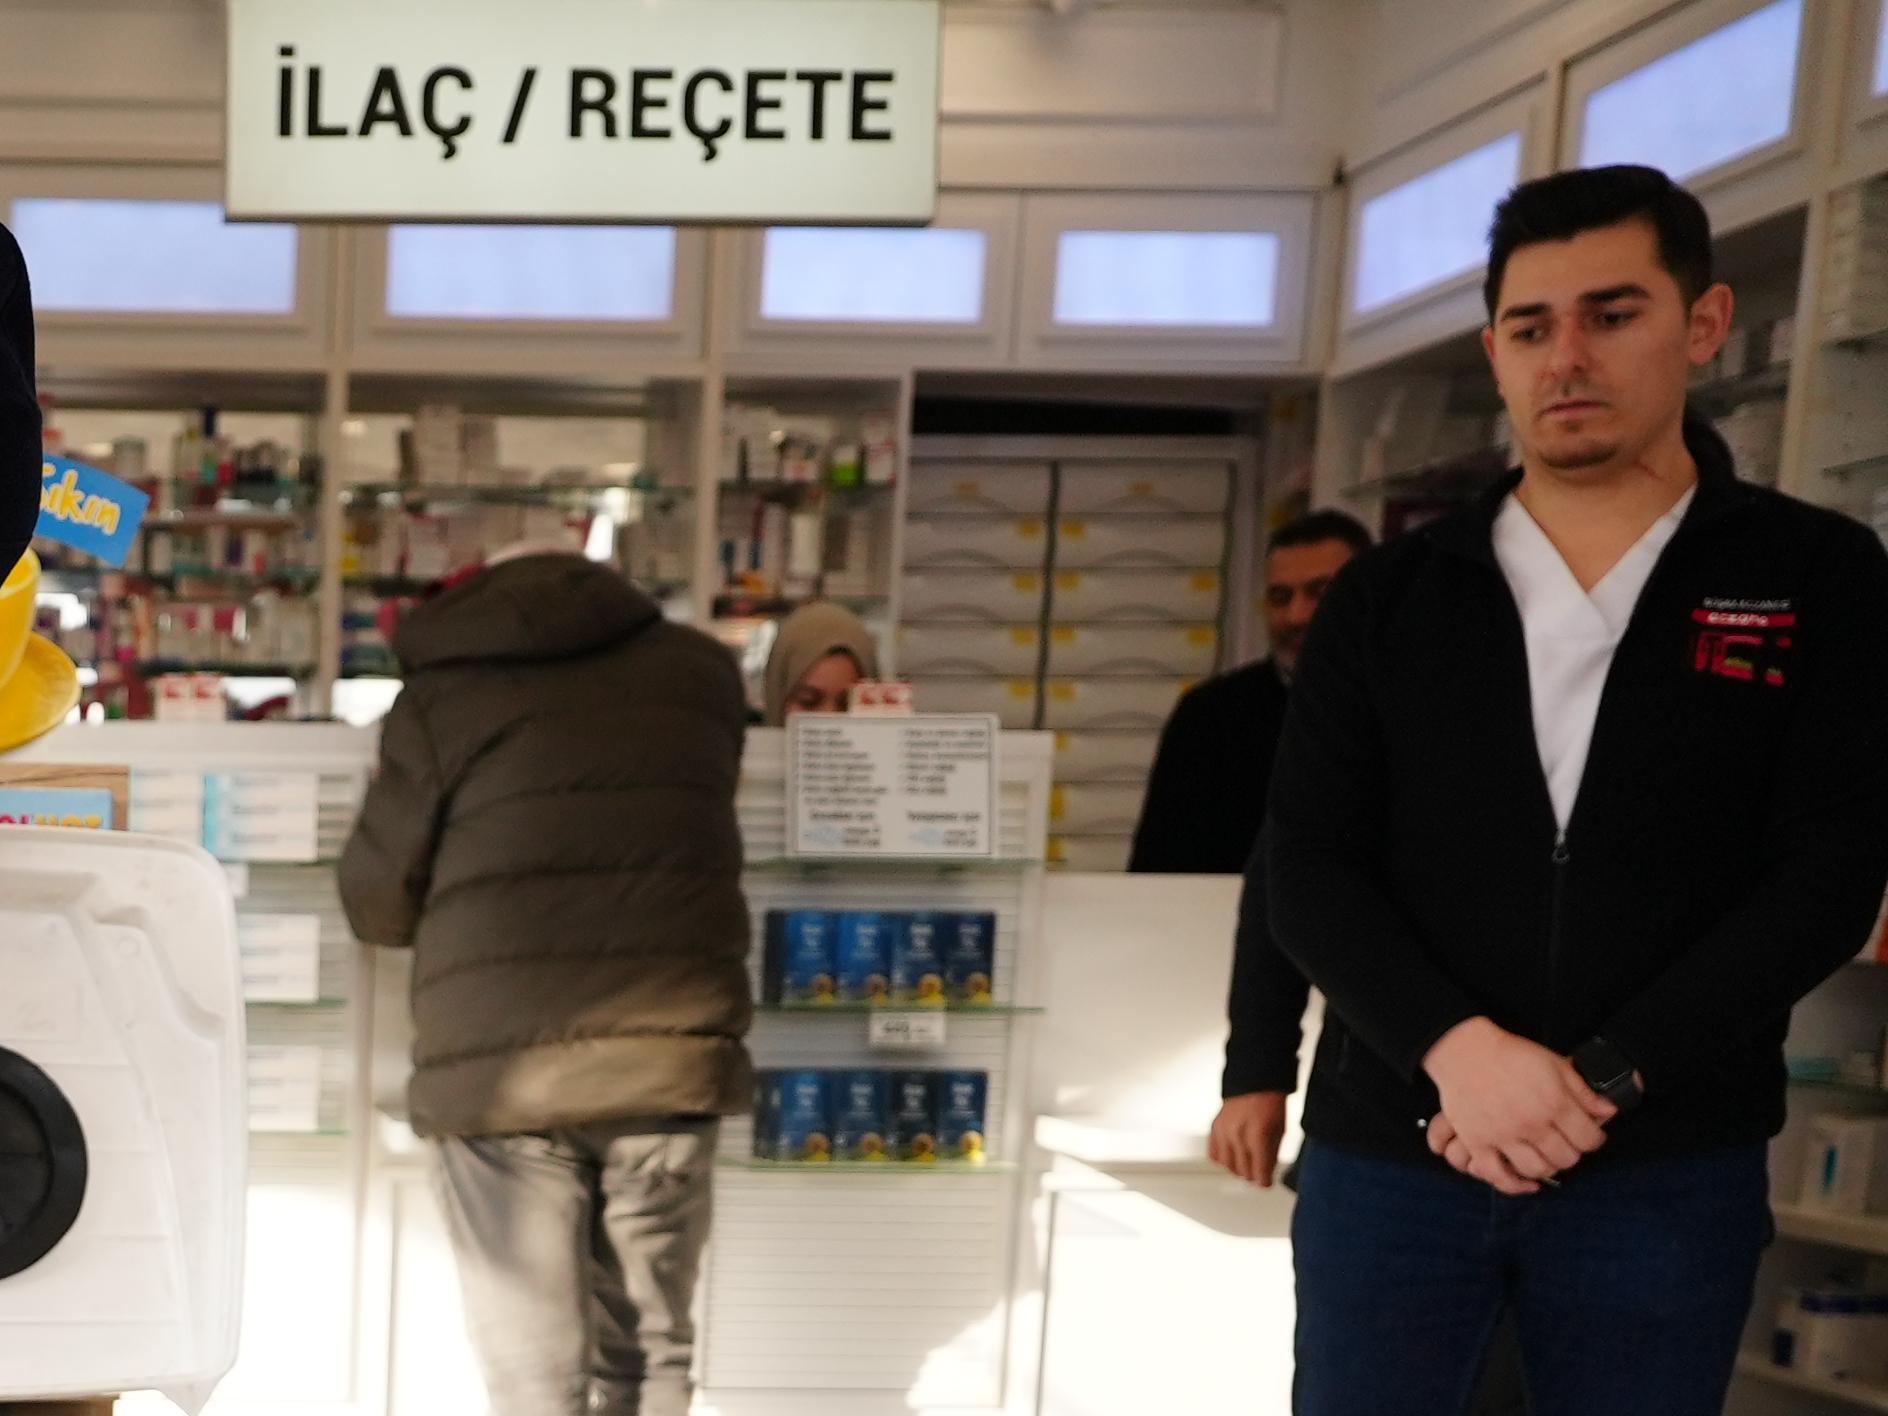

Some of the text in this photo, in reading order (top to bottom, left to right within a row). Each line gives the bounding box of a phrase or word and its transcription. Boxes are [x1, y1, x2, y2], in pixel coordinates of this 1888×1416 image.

[277, 45, 896, 162] İLAÇ / REÇETE
